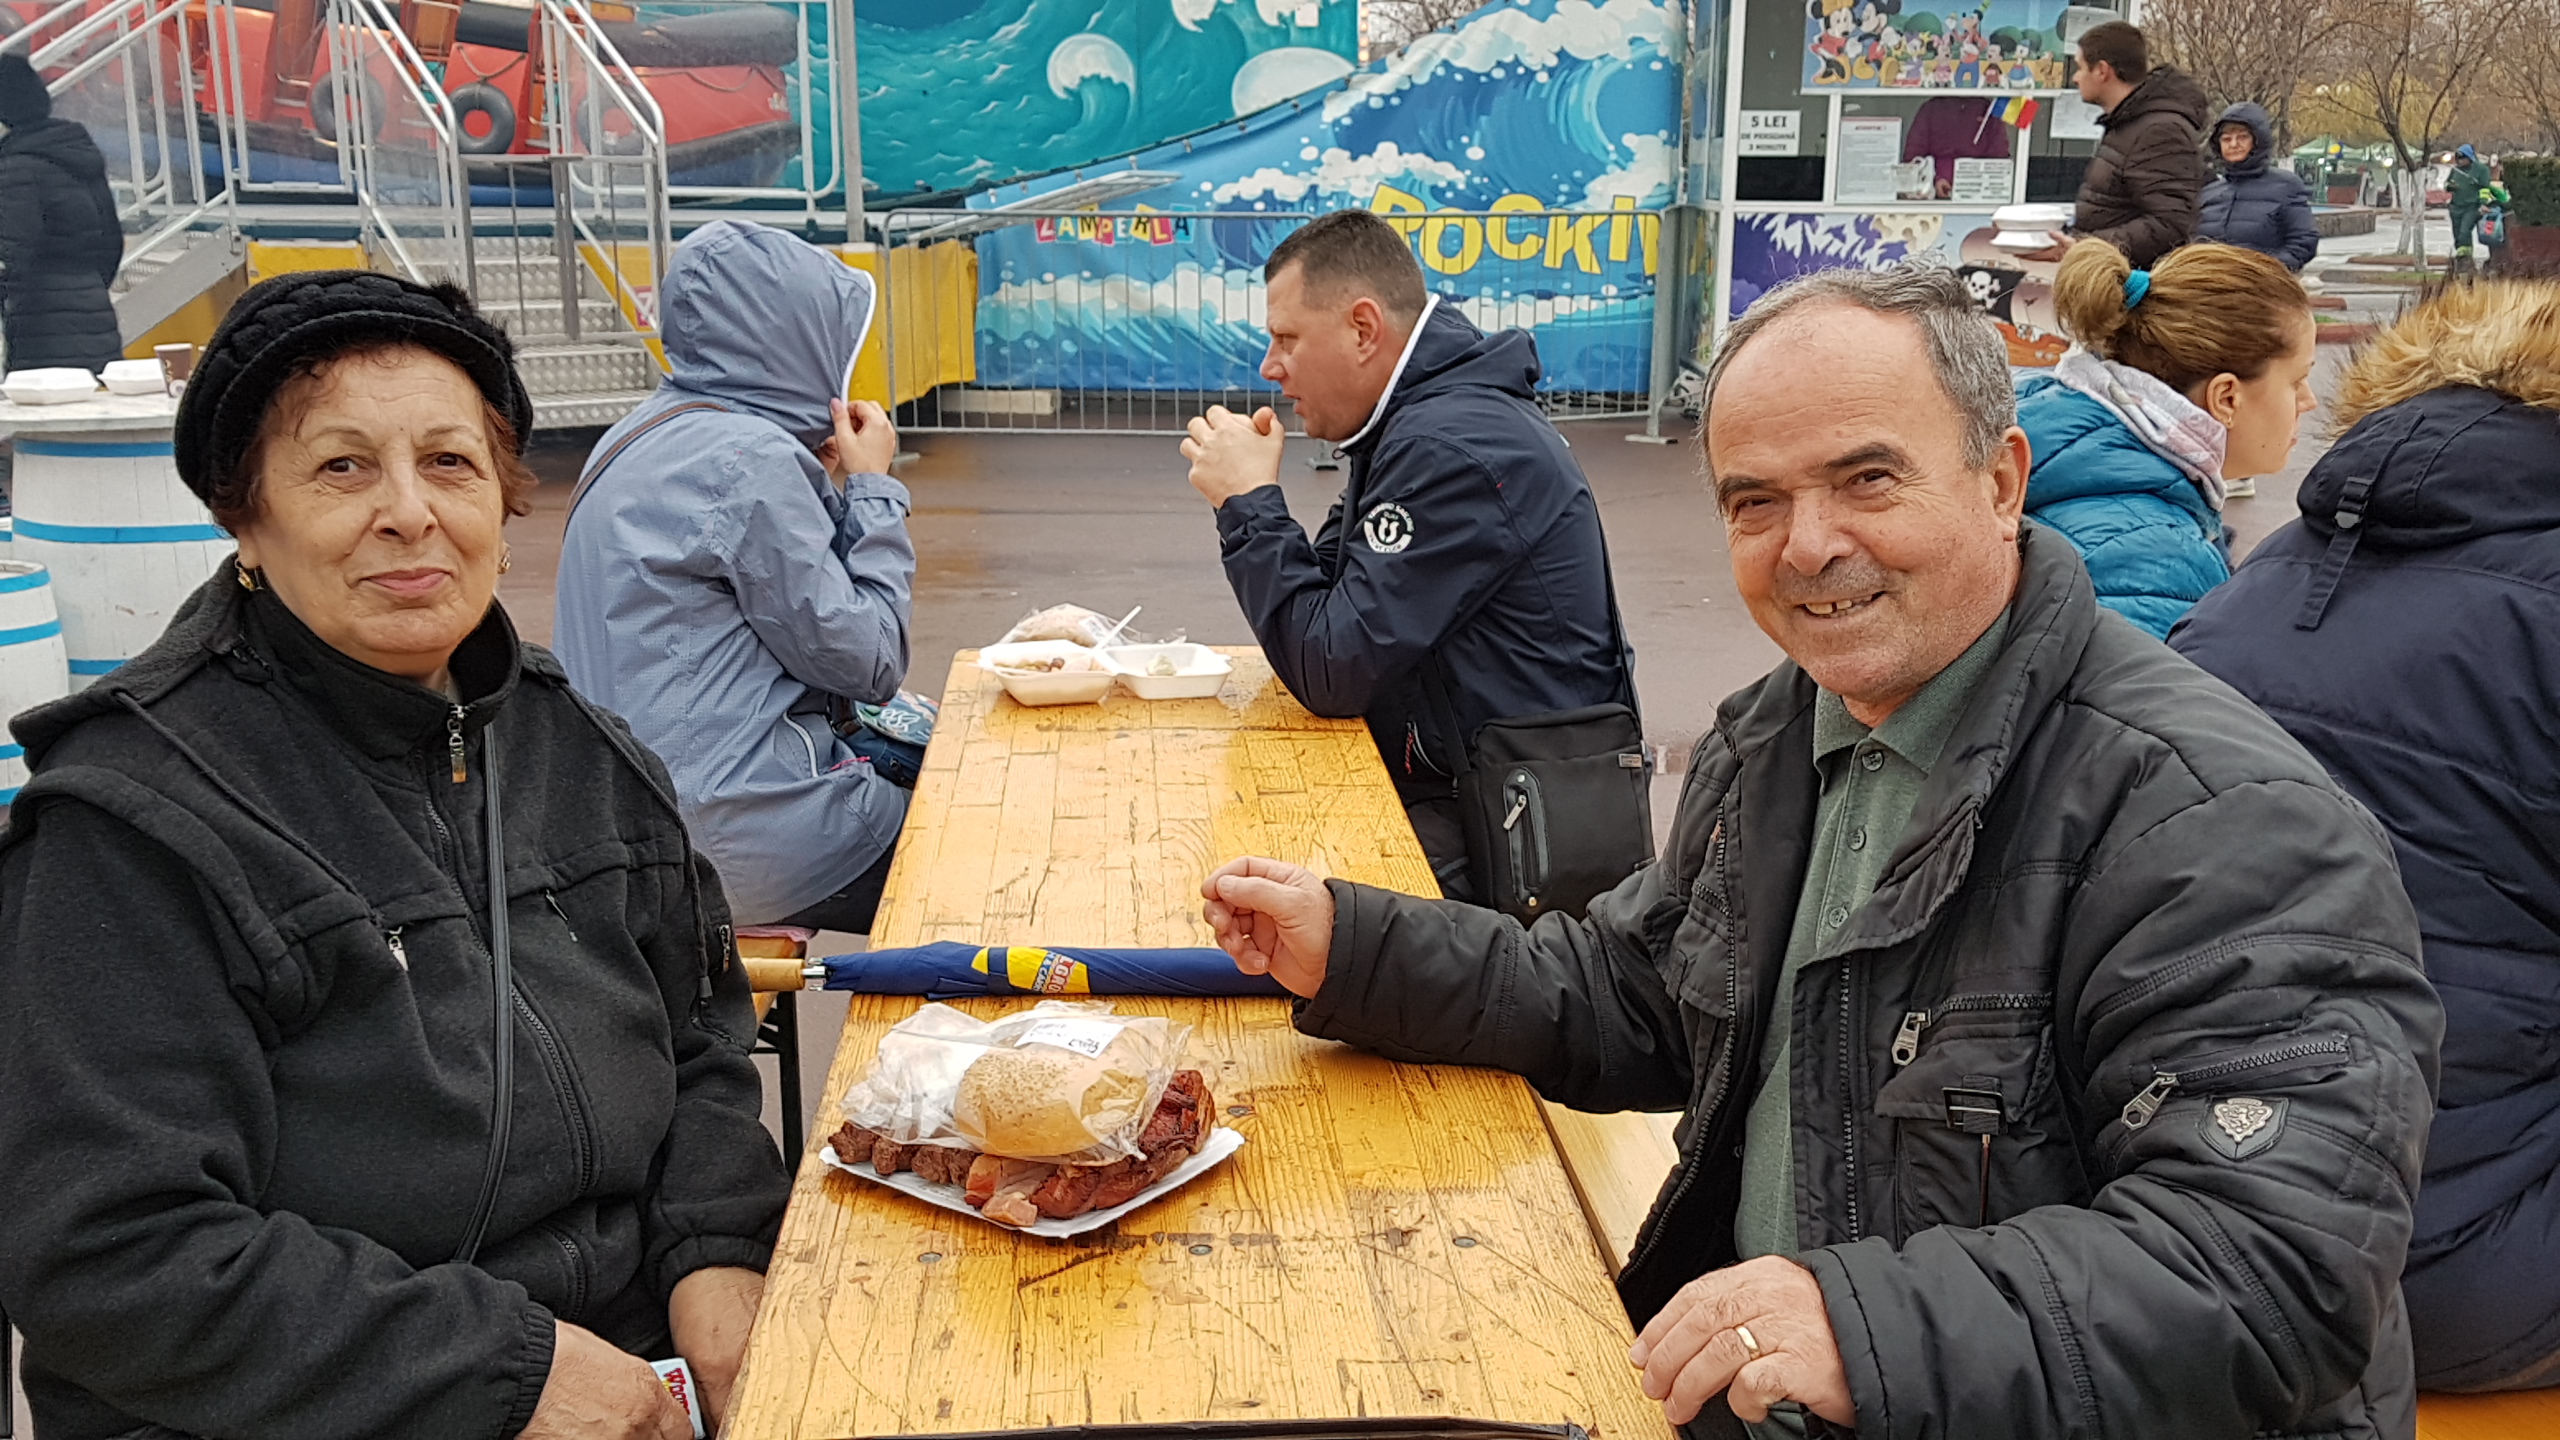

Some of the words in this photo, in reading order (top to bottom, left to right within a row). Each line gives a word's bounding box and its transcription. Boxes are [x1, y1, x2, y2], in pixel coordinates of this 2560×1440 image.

[1751, 116, 1759, 128] 5
[1764, 116, 1787, 128] LEI
[1037, 205, 1194, 244] ZAMPERLA
